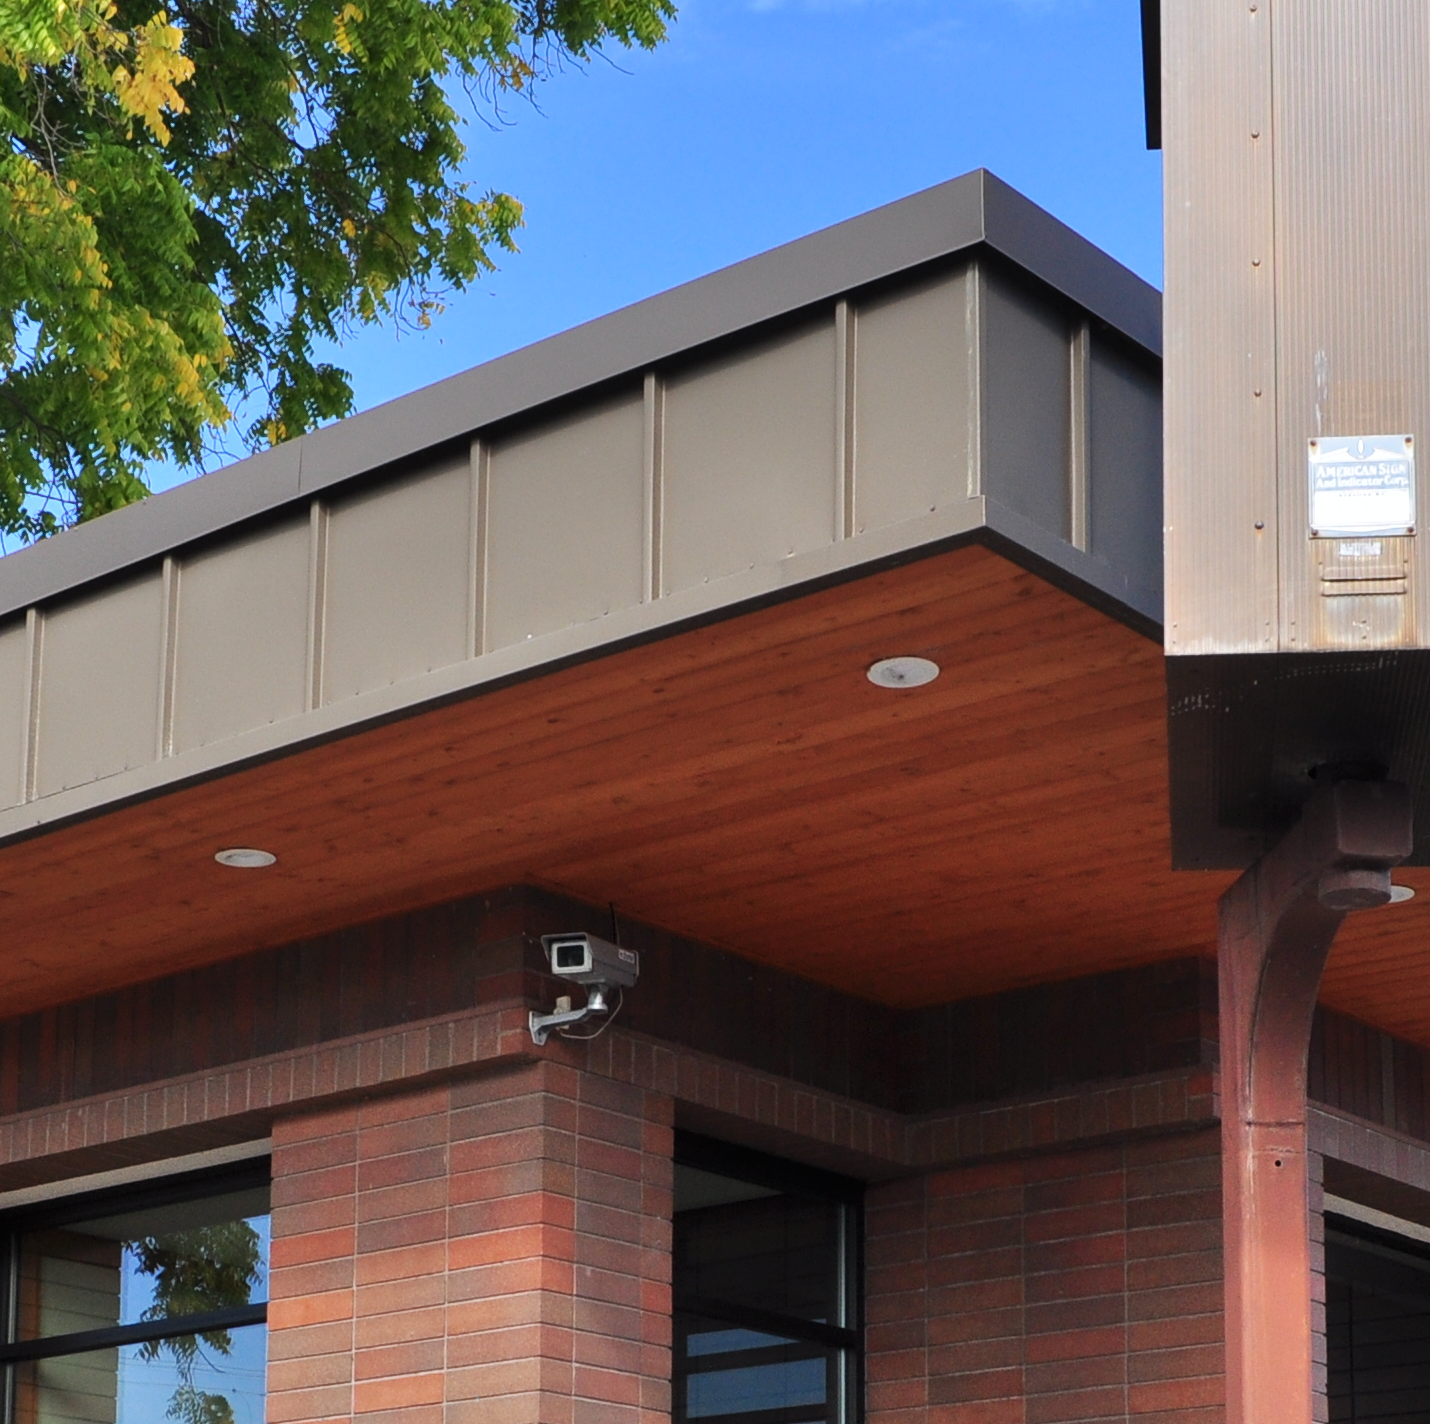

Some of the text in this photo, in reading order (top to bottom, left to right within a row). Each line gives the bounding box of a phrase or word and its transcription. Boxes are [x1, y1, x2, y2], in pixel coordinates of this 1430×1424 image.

[1316, 462, 1406, 478] AMERICAN SIGN
[1316, 477, 1337, 488] And
[1337, 476, 1383, 487] Indicator
